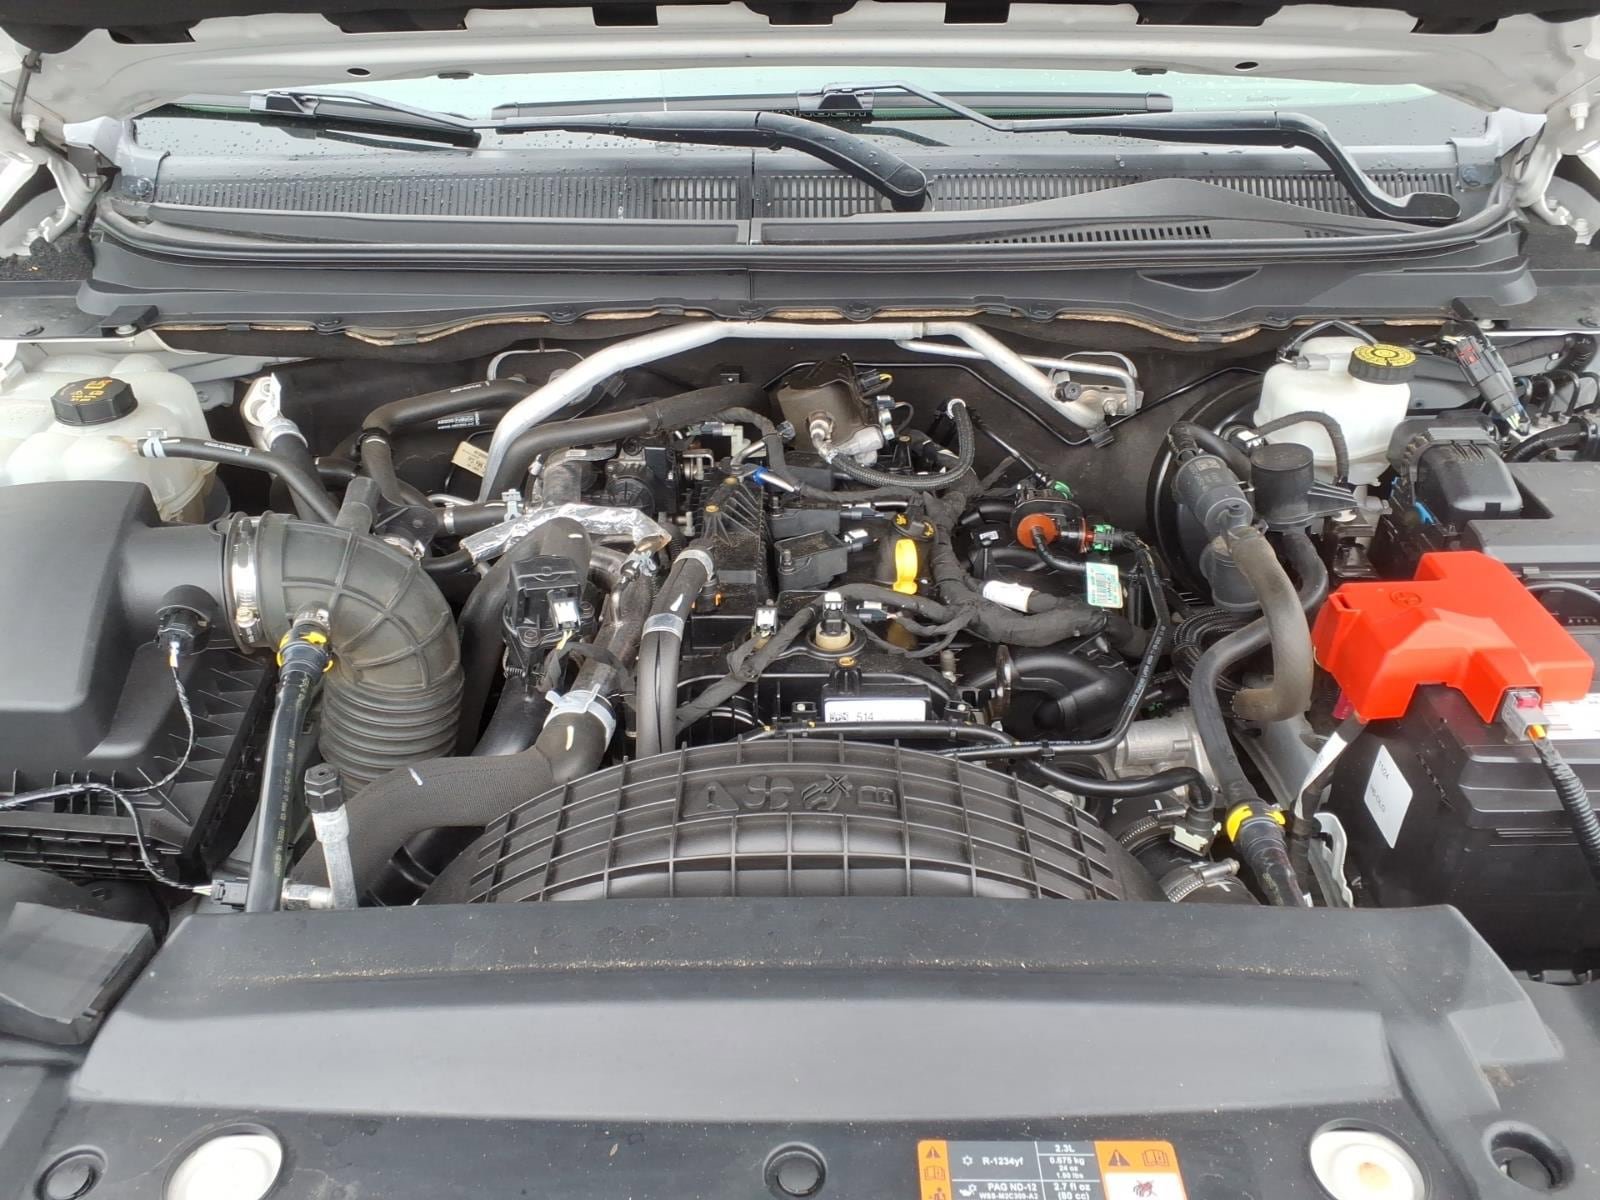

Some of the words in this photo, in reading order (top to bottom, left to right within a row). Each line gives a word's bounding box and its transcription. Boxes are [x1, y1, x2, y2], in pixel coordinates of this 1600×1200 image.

[1054, 1144, 1075, 1153] 2.3L
[982, 1156, 1024, 1167] R-1234yf
[1073, 1157, 1085, 1166] kg
[988, 1183, 1008, 1191] PAG
[1010, 1183, 1037, 1191] ND-12
[1054, 1183, 1067, 1191] 2.7
